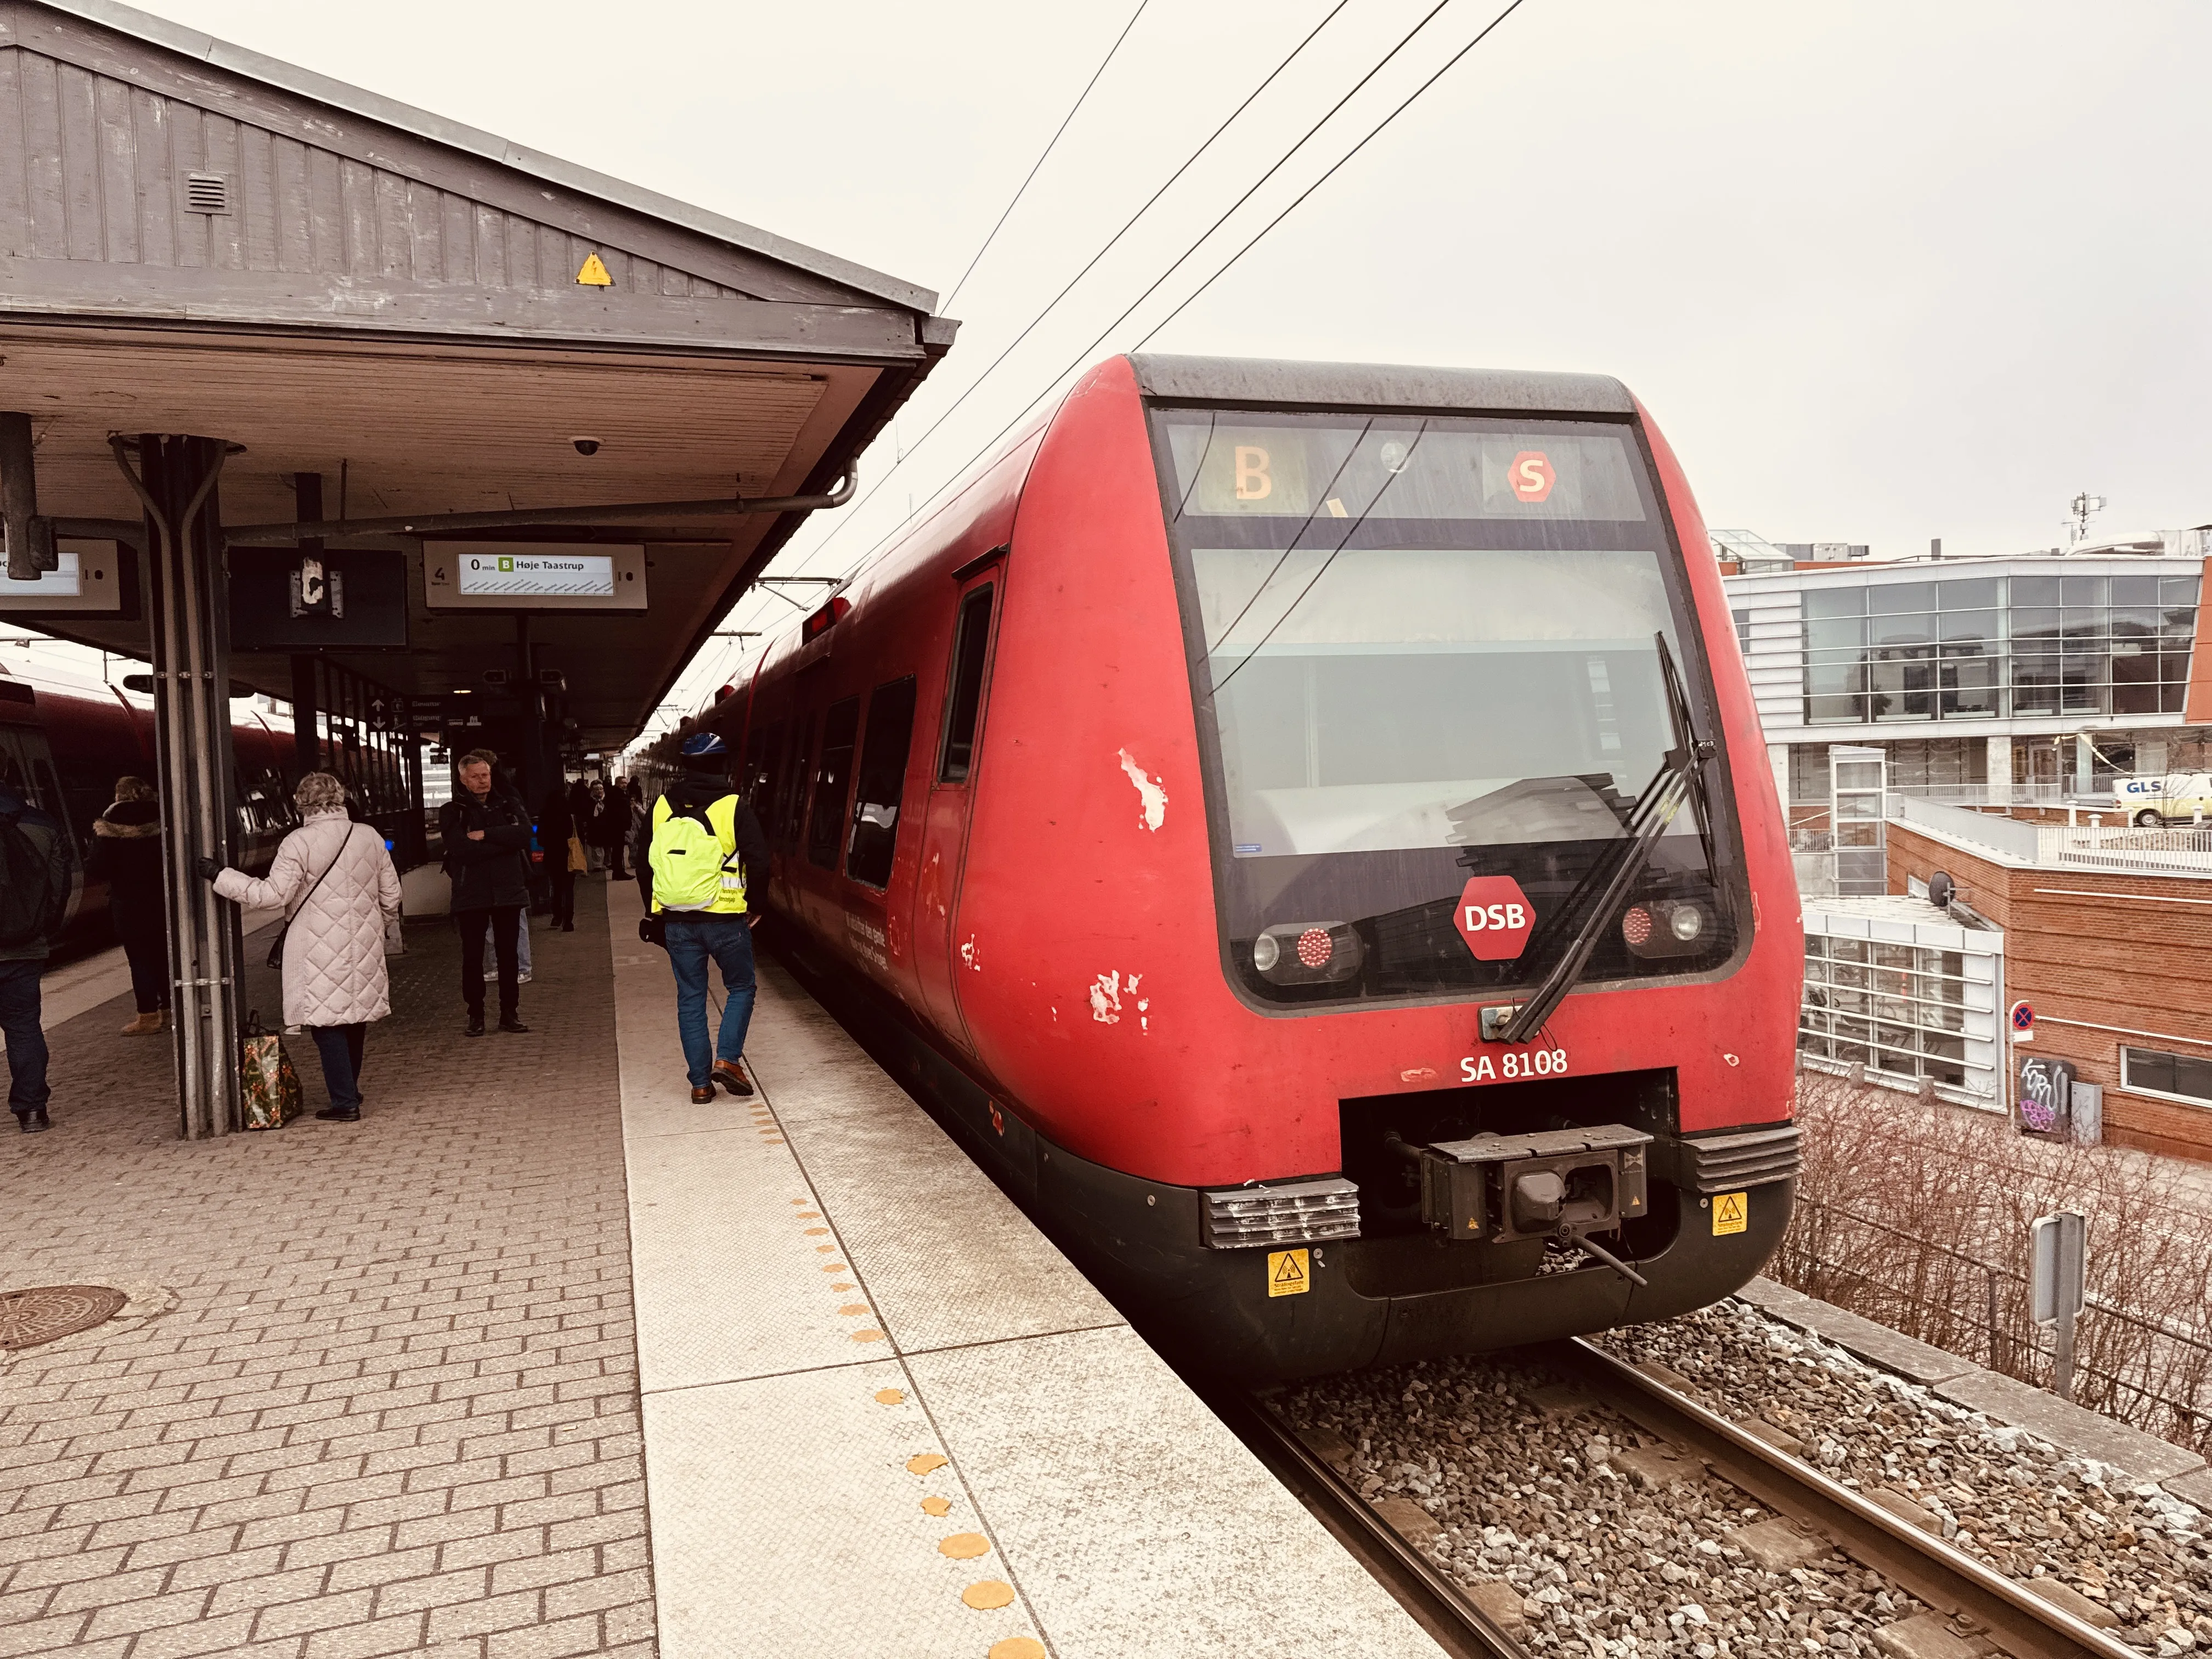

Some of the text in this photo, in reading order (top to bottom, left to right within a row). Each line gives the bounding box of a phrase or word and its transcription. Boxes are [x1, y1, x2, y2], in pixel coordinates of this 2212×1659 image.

[1235, 446, 1272, 499] B
[1520, 459, 1545, 492] S
[435, 567, 445, 580] 4
[471, 559, 479, 570] 0
[502, 560, 510, 569] B
[516, 561, 540, 570] Høje
[542, 561, 584, 571] Taastrup
[2126, 781, 2162, 793] GLS
[1465, 904, 1526, 931] DSB
[1460, 1048, 1568, 1082] SA 8108
